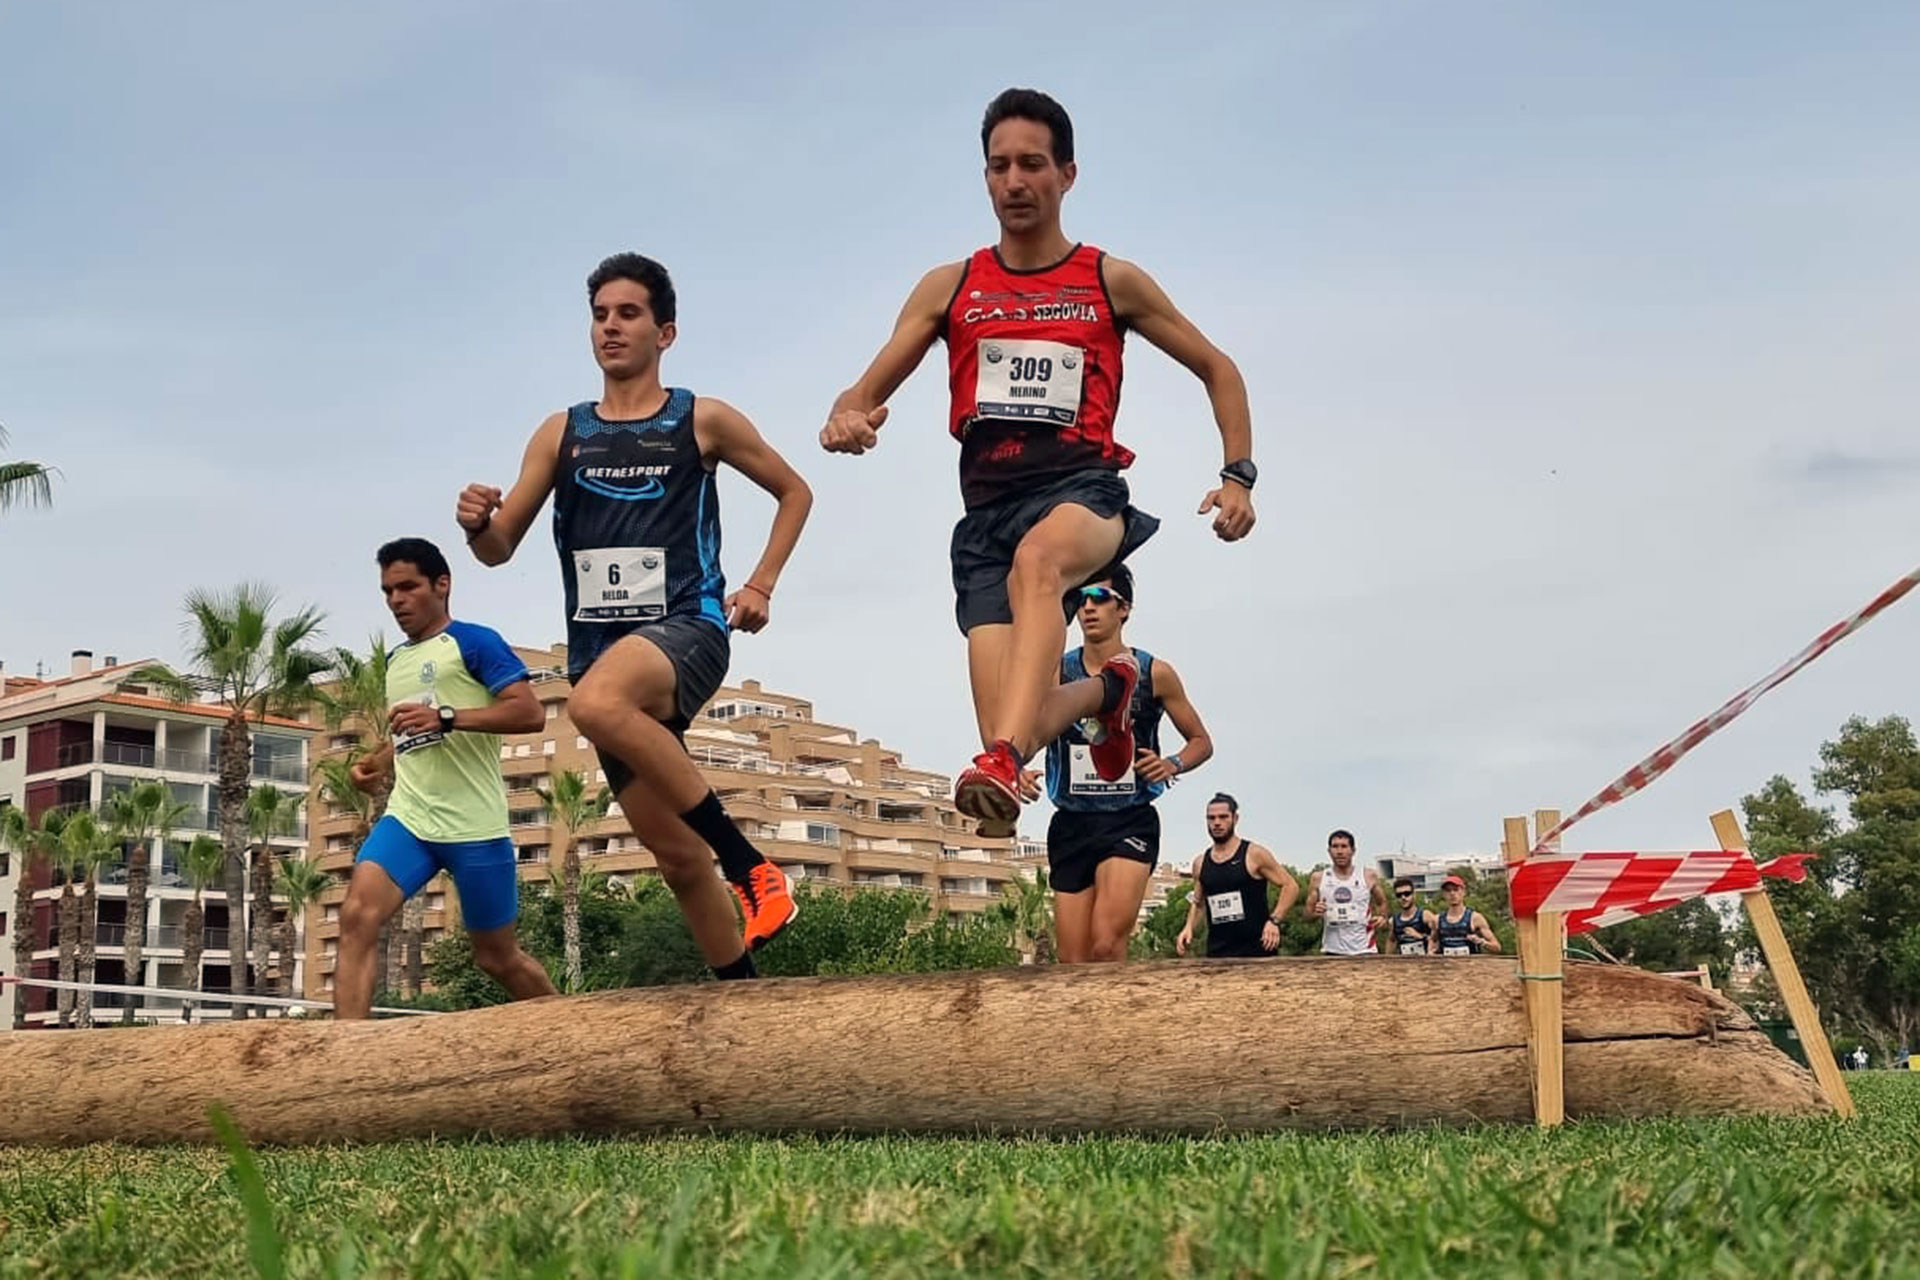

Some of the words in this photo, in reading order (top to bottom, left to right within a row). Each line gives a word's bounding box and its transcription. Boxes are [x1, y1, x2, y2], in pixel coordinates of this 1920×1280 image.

[1033, 303, 1098, 321] SEGOVIA
[1010, 357, 1053, 382] 309
[1009, 386, 1047, 398] MERINO
[585, 465, 671, 478] METAESPORT
[608, 563, 621, 586] 6
[602, 590, 629, 601] BELDA
